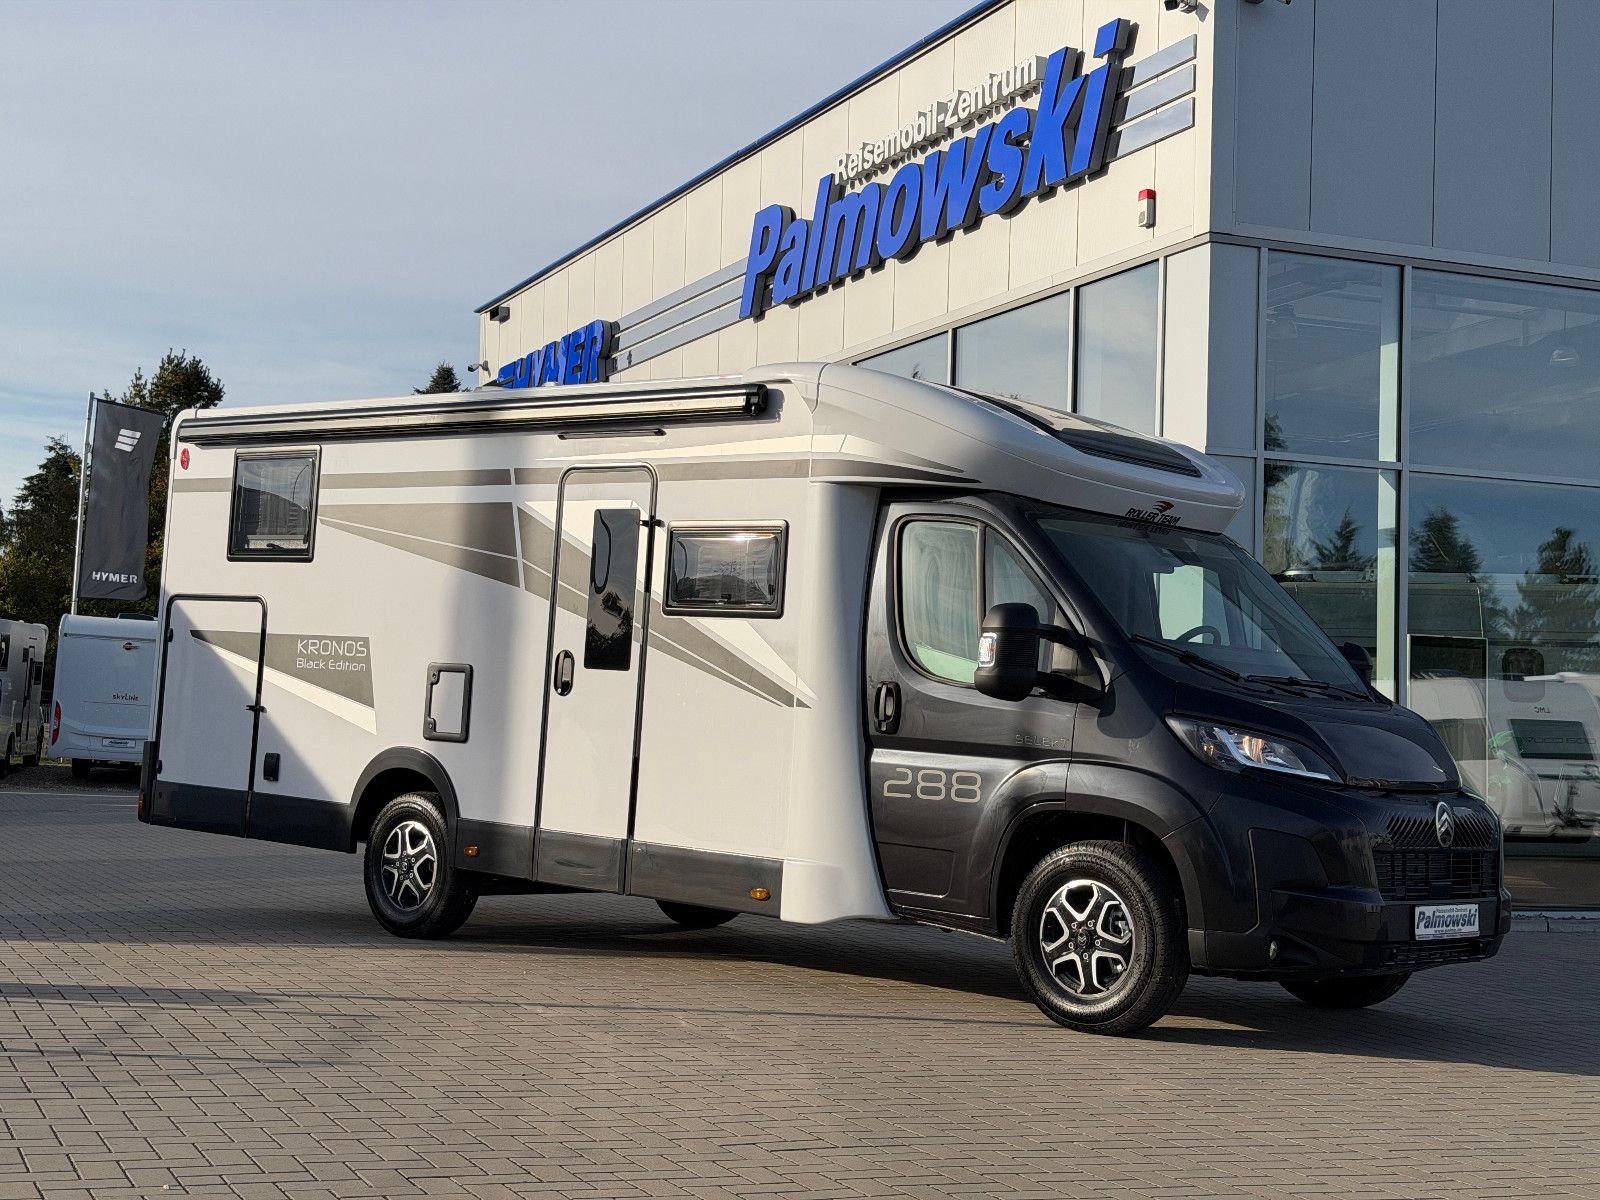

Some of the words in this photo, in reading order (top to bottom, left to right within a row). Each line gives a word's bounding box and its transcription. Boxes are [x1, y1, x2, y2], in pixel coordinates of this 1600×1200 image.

[834, 55, 1038, 186] Reisemobil-Zentrum
[740, 18, 1127, 318] Palmowski
[1125, 508, 1159, 521] ROLLER
[1158, 513, 1181, 526] TEAM
[92, 571, 138, 584] HYMER
[297, 639, 367, 657] KRONOS
[296, 657, 326, 670] Black
[328, 660, 366, 672] Edition
[883, 767, 982, 803] 288
[1416, 908, 1478, 930] Palmowski
